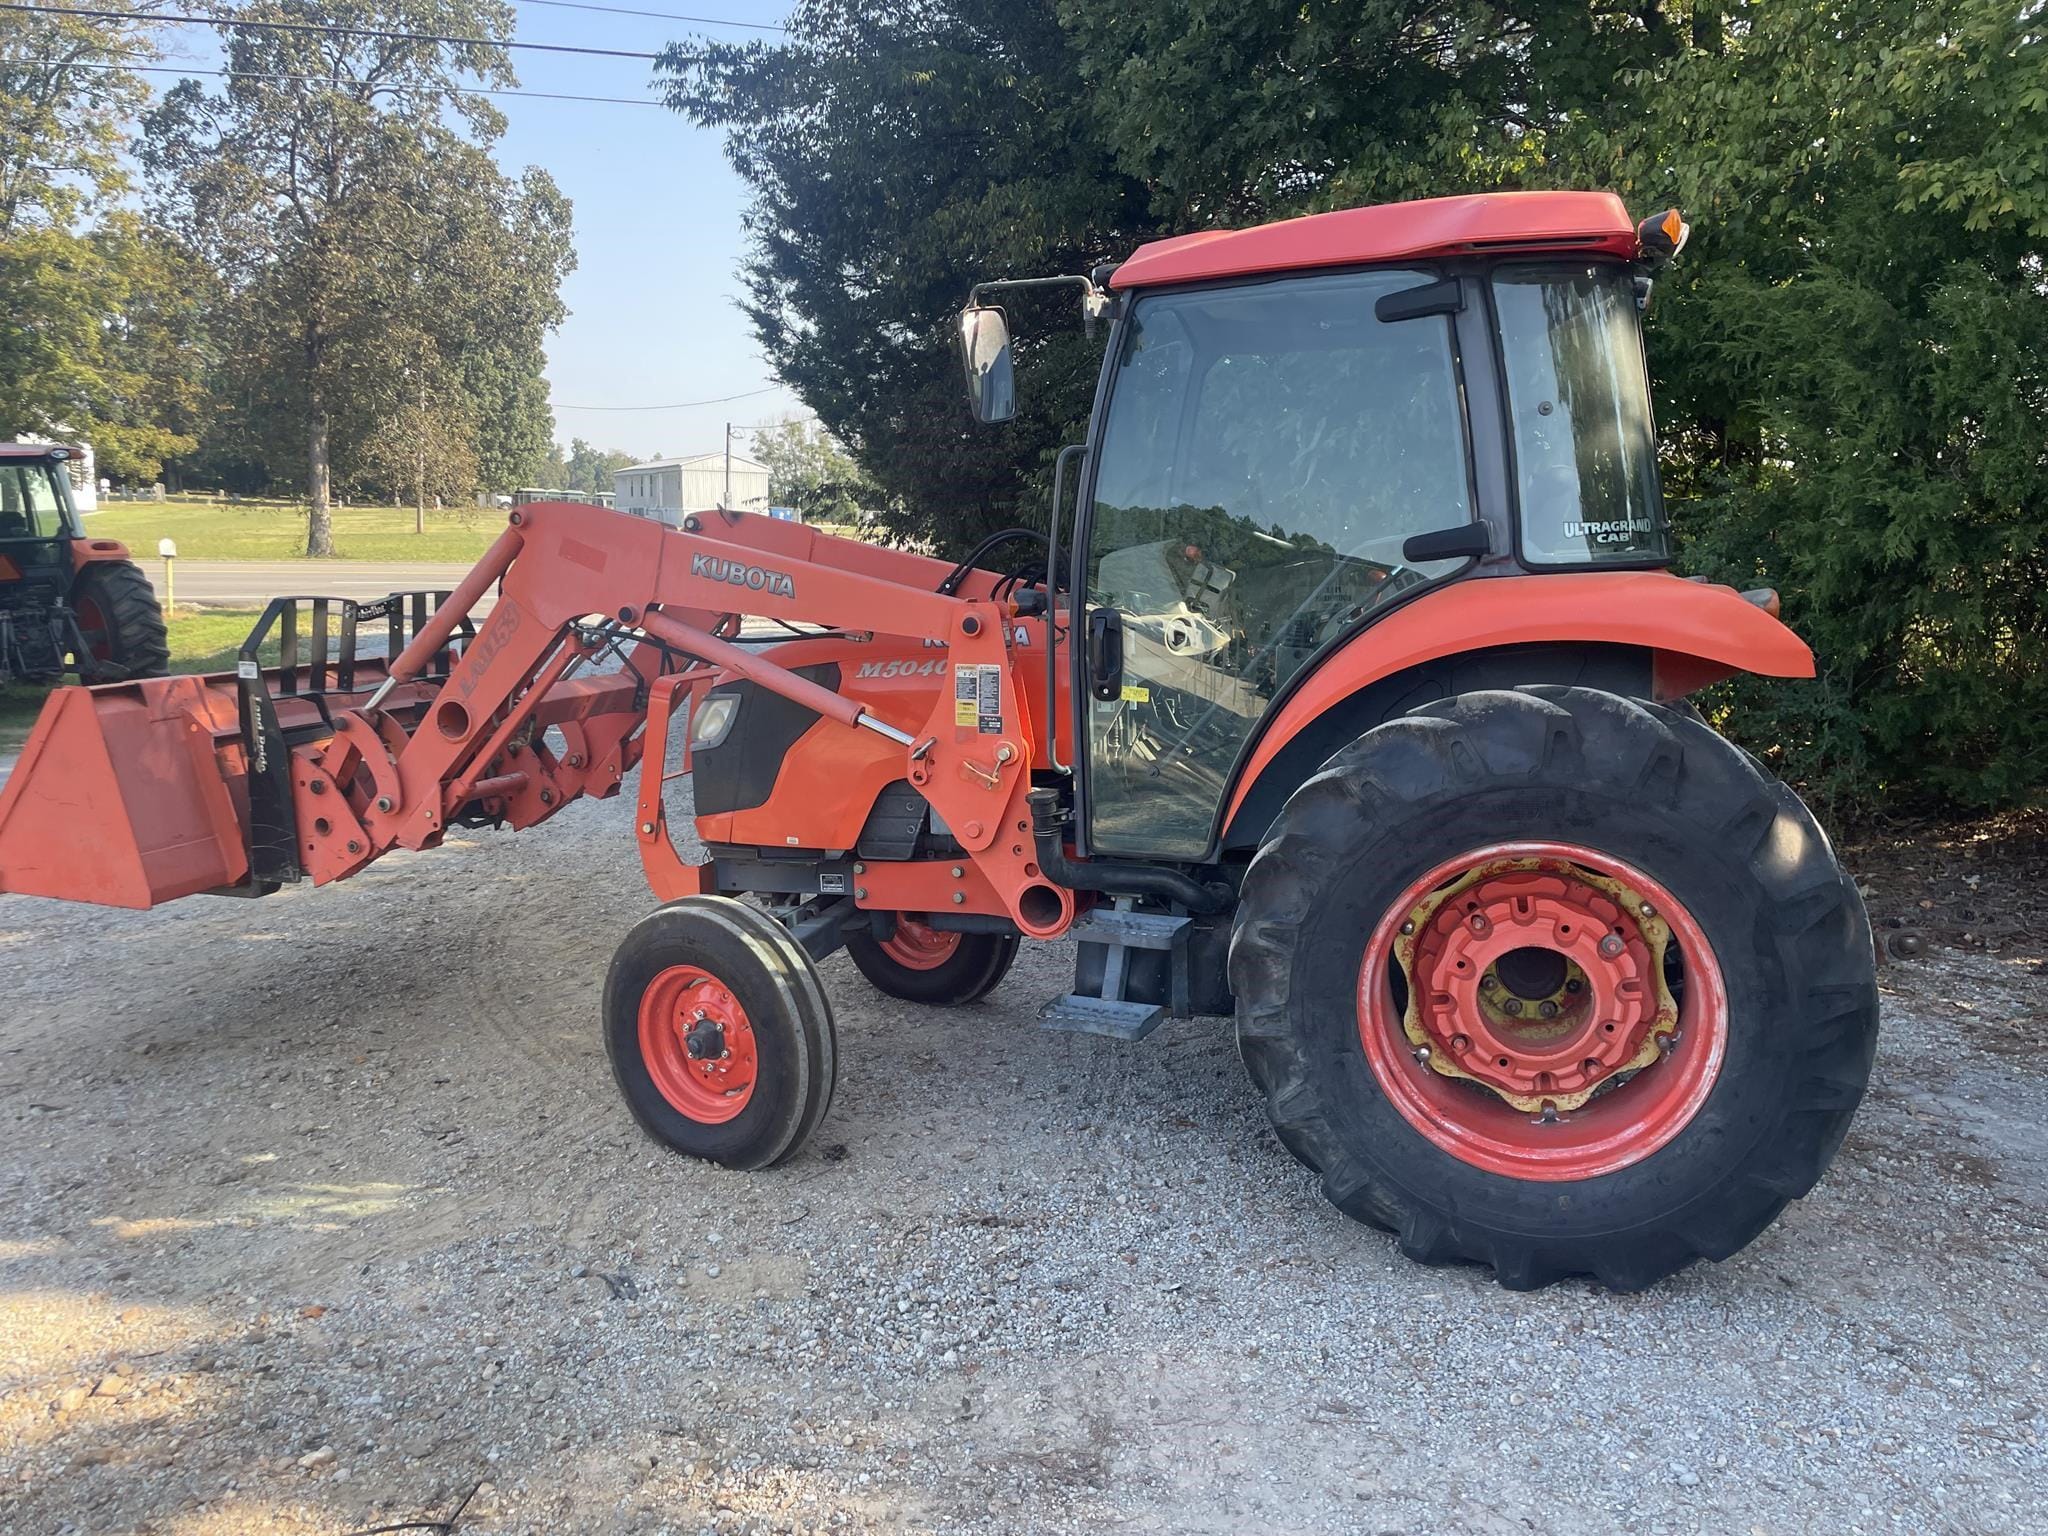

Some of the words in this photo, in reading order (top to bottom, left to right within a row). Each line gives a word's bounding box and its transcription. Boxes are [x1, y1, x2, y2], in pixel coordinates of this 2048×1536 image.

[1564, 518, 1651, 538] ULTRAGRAND
[1597, 532, 1630, 543] CAB
[691, 553, 795, 599] KUBOTA
